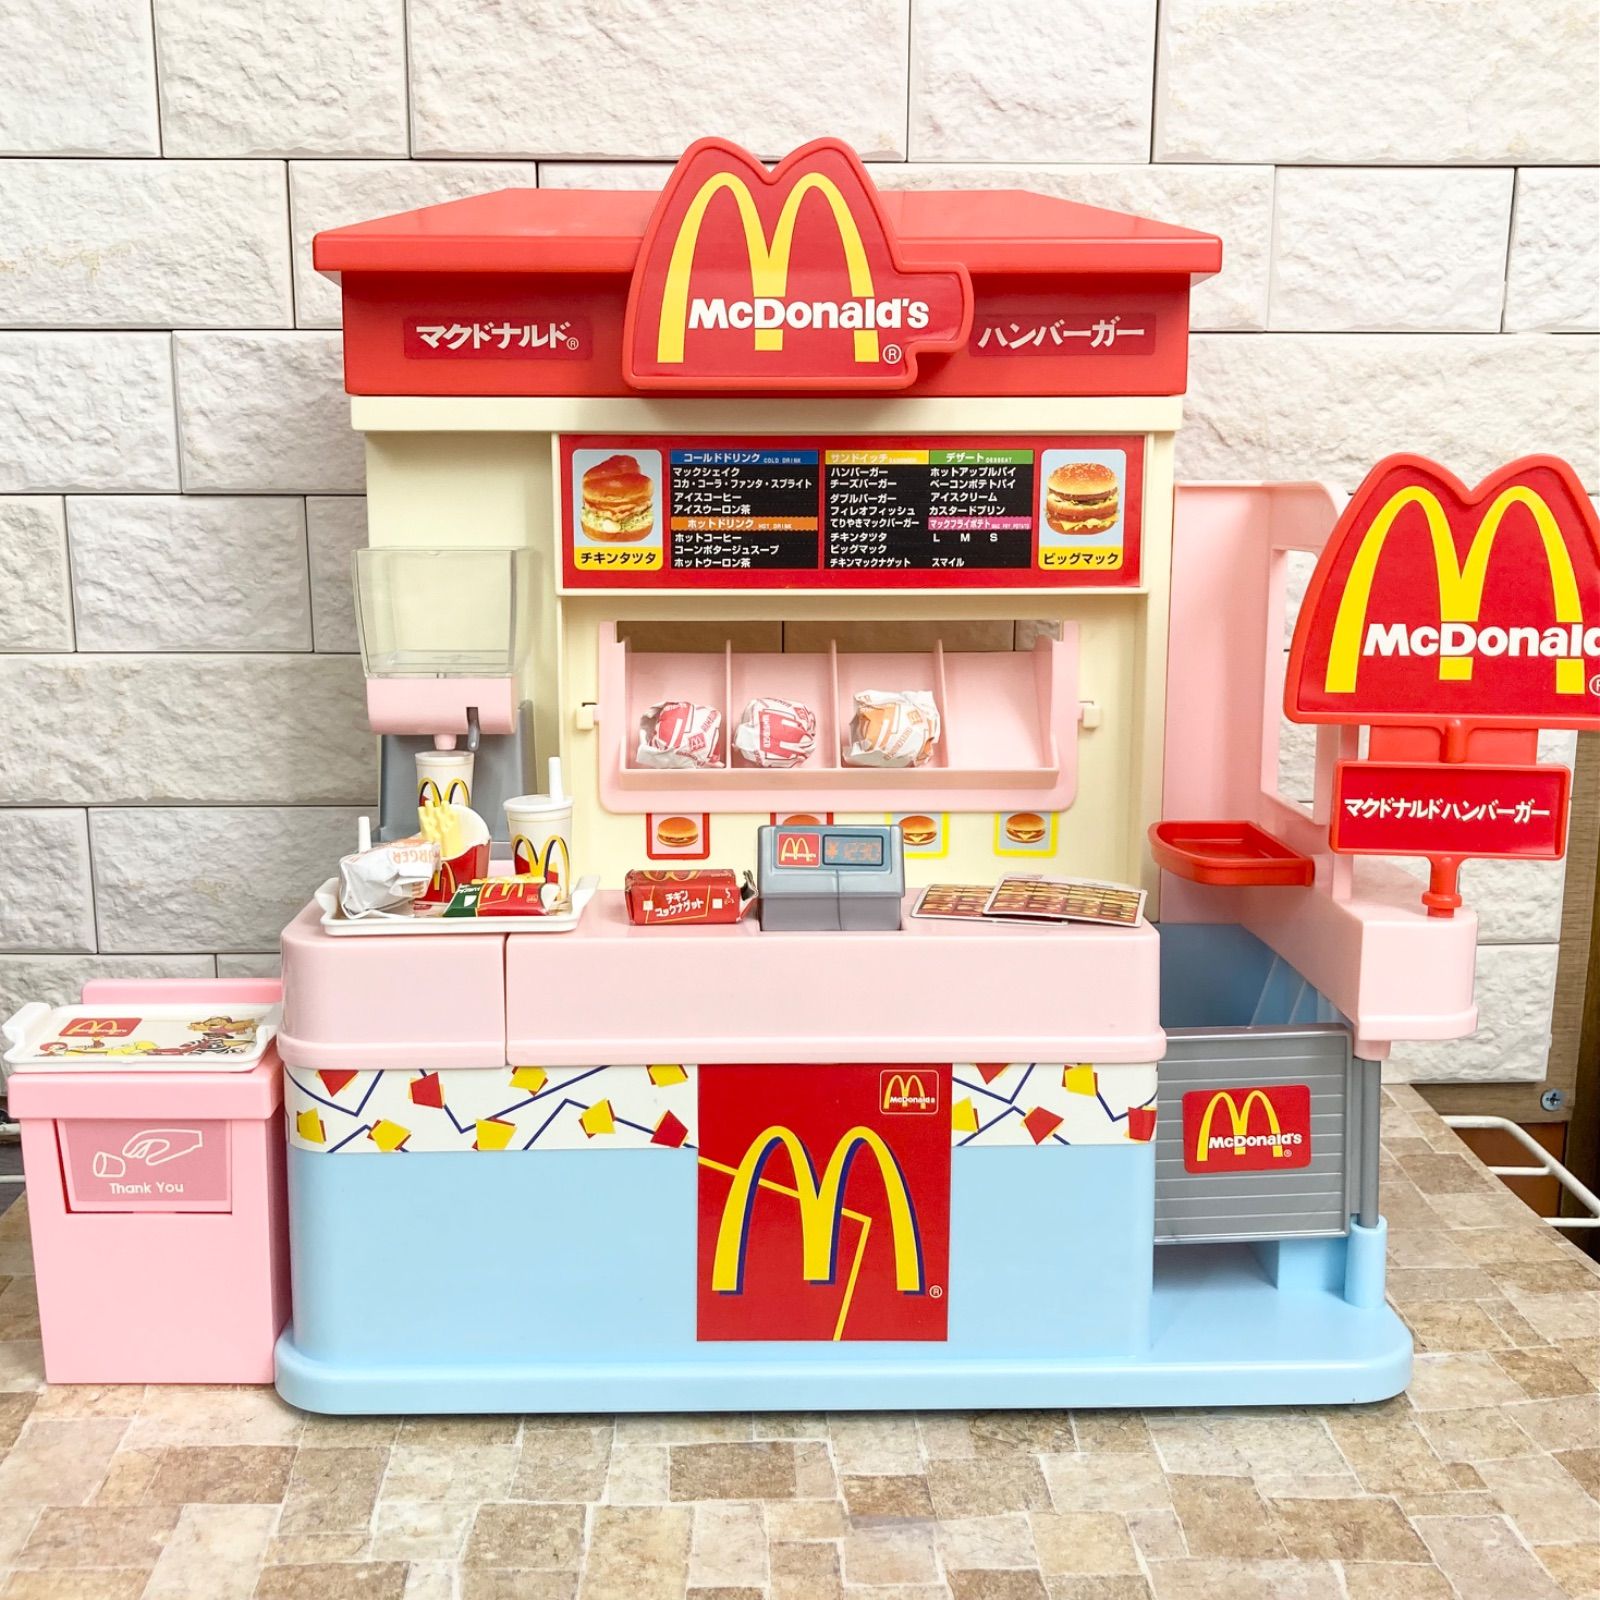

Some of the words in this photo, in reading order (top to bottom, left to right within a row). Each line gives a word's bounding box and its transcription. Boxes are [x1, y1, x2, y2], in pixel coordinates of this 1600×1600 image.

[688, 298, 929, 329] McDonald's
[978, 315, 1145, 349] ハンバーガー
[684, 453, 760, 463] コールドドリンク
[831, 453, 888, 464] サンドイッチ
[946, 452, 984, 463] デザート
[673, 467, 740, 477] マックシェイク
[831, 467, 888, 477] ハンバーガー
[830, 479, 897, 488] チーズバーガー
[674, 492, 742, 502] アイスコーヒー
[830, 493, 897, 504] ダブルバーガー
[930, 492, 998, 502] アイスクリーム
[673, 504, 751, 515] アイスウーロン茶
[830, 506, 916, 516] フィレオフィッシュ
[929, 505, 1006, 516] カスタードプリン
[687, 519, 754, 529] ホットドリンク
[830, 518, 920, 528] てりやきマックバーガー
[930, 519, 991, 529] マックフライポテト
[675, 533, 742, 543] ホットコーヒー
[830, 532, 887, 542] チキンタツタ
[933, 533, 940, 542] L
[960, 533, 970, 542] M
[989, 533, 998, 542] S
[675, 545, 779, 555] コーンポタージュスープ
[830, 544, 887, 554] ビッグマック
[580, 552, 656, 564] チキンタツタ
[674, 558, 751, 568] ホットウーロン茶
[830, 558, 912, 568] チキンマックナゲット
[932, 558, 965, 567] スマイル
[1043, 553, 1119, 565] ビッグマック
[1344, 797, 1550, 824] マクドナルドハンバーガー
[1208, 1133, 1303, 1149] McDonald's
[109, 1182, 152, 1194] Thank
[156, 1182, 184, 1194] You
